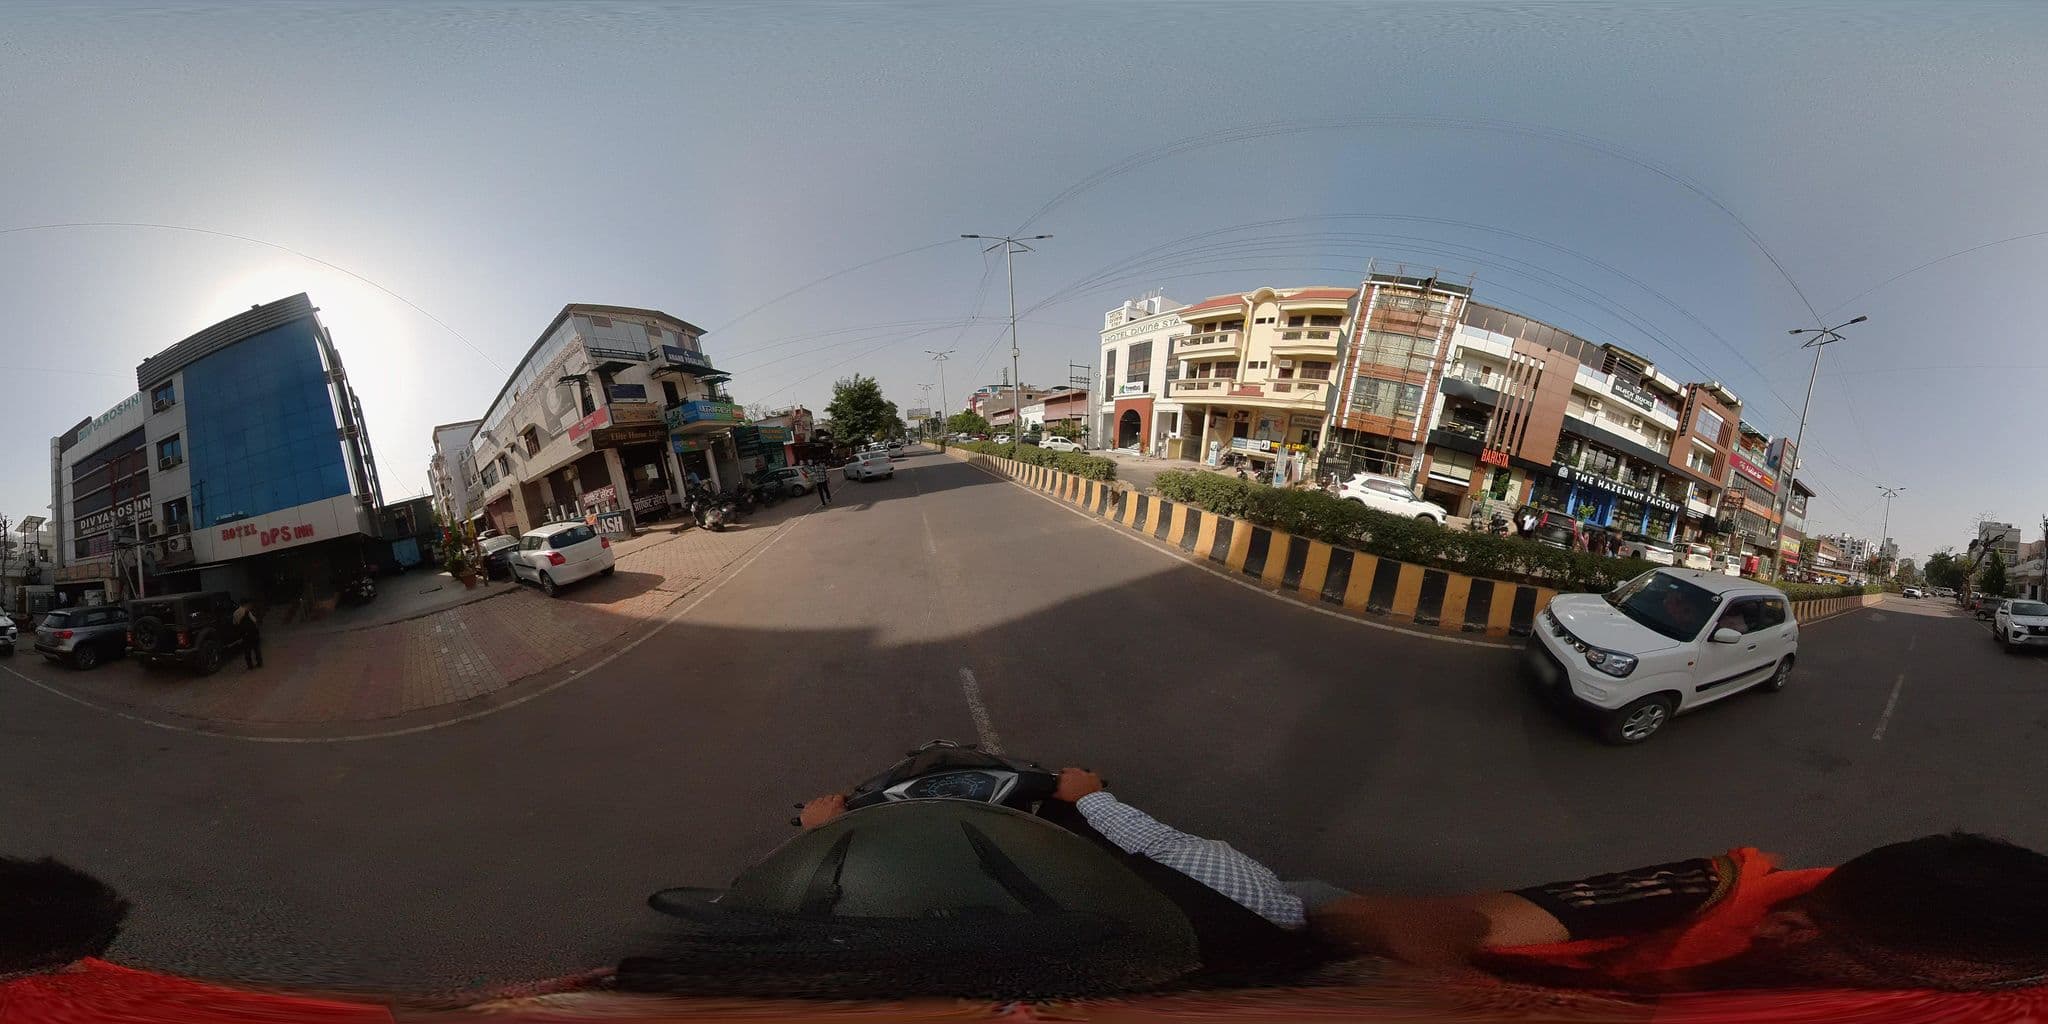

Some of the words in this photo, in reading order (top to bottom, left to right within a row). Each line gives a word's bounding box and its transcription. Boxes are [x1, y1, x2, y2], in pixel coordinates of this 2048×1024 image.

[1104, 331, 1128, 343] HOTEL
[1615, 385, 1635, 398] BLACK
[1481, 448, 1509, 468] BARISTA
[1574, 472, 1595, 485] THE
[1597, 479, 1645, 502] HAZELNUT
[1646, 496, 1681, 512] FACTORY
[222, 523, 257, 541] HOTEL
[260, 525, 291, 547] DPS
